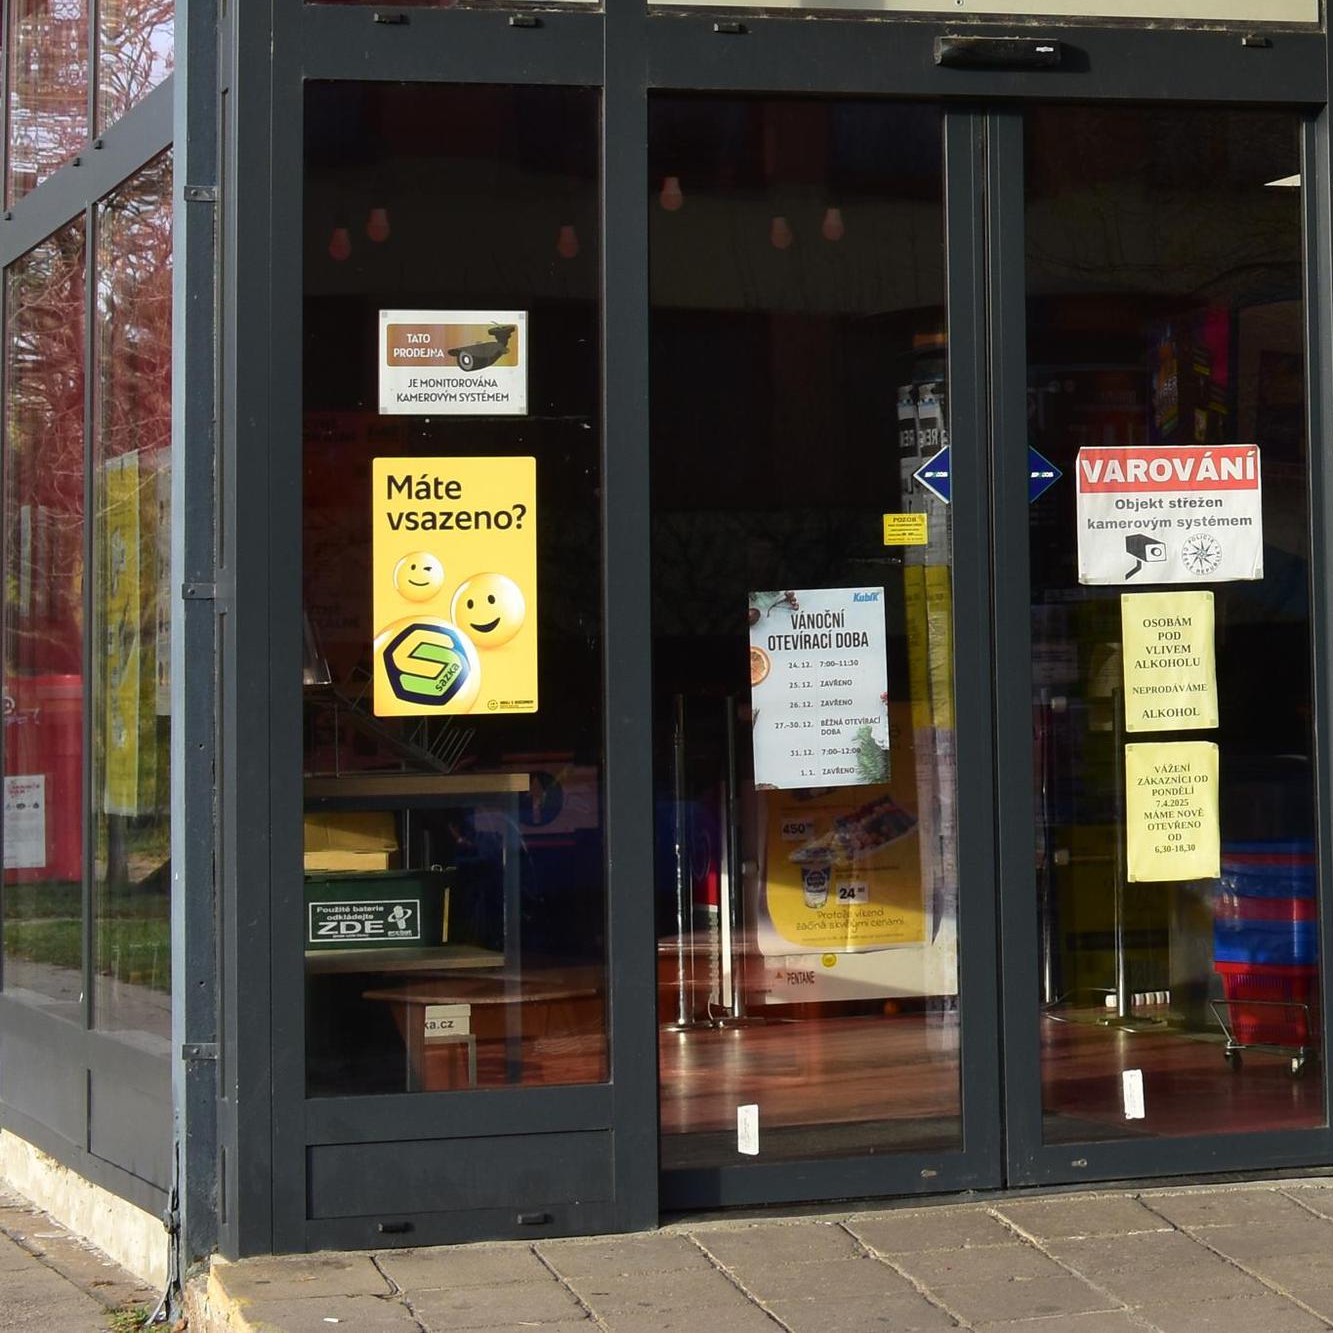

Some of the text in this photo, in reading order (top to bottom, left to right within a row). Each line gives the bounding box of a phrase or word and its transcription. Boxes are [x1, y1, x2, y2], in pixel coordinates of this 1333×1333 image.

[406, 333, 431, 344] TATO
[393, 347, 445, 358] PRODEJNA
[408, 375, 498, 388] JE MONITOROVÁNA
[396, 390, 509, 403] KAMEROVÝM SYSTÉMEM
[1081, 451, 1256, 484] VAROVÁNÍ
[386, 473, 462, 501] Máte
[1115, 497, 1223, 511] Objekt střežen
[386, 503, 526, 533] vsazeno?
[1087, 516, 1252, 531] kamerovým systémem
[791, 609, 845, 630] VÁNOČNÍ
[1142, 615, 1192, 628] OSOBÁM
[768, 630, 869, 651] OTEVÍRACÍ DOBA
[1158, 631, 1182, 641] POD
[1145, 644, 1192, 655] VLIVEM
[1134, 657, 1201, 669] ALKOHOLU
[435, 662, 460, 692] sazka
[820, 678, 853, 688] ZAVŘENO
[1132, 683, 1208, 694] NEPRODÁVÁME
[820, 698, 853, 707] ZAVŘENO
[1142, 707, 1201, 719] ALKOHOL
[820, 718, 843, 727] BĚŽNÁ
[844, 716, 881, 725] OTEVÍRACÍ
[821, 728, 841, 736] DOBA
[822, 765, 855, 775] ZAVŘENO
[1154, 763, 1191, 774] VÁŽENÍ
[1137, 775, 1208, 786] ZÁKAZNÍCI OD
[1151, 786, 1194, 796] PONDĚLÍ
[1156, 799, 1189, 808] 7.4.2025
[1144, 810, 1176, 819] MÁME
[1147, 820, 1202, 831] OTEVŘENO
[1168, 833, 1182, 841] OD
[839, 887, 856, 899] 24
[317, 920, 385, 935] ZDE
